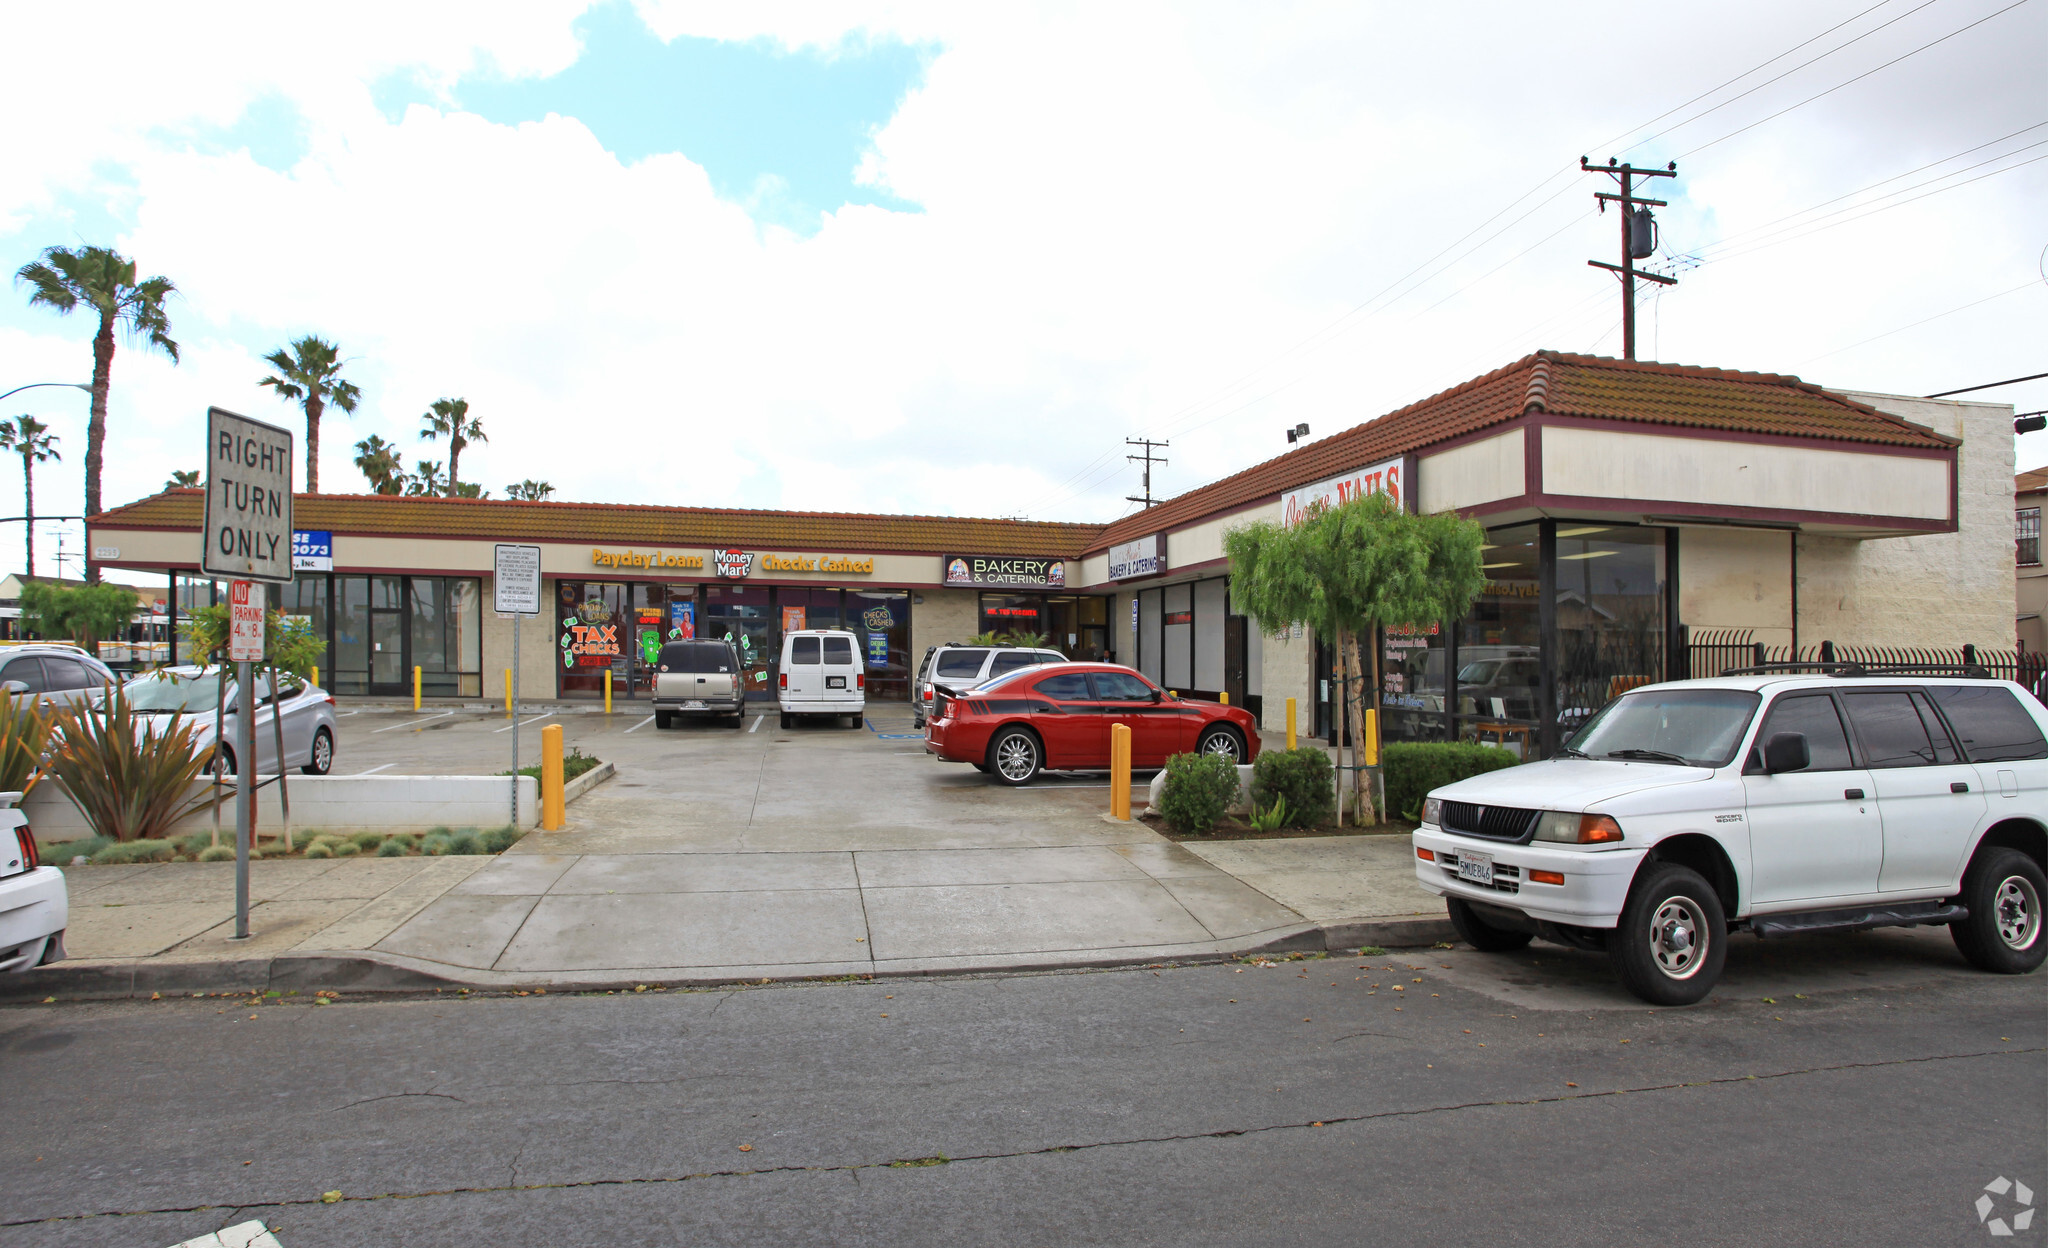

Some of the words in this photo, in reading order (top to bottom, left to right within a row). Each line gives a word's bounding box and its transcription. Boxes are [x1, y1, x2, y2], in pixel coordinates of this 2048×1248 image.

[219, 430, 287, 475] RIGHT
[220, 478, 281, 519] TURN
[219, 526, 281, 561] ONLY
[592, 548, 652, 569] Payday
[656, 551, 704, 568] Loans
[713, 549, 754, 569] Money
[761, 554, 814, 572] Checks
[819, 556, 874, 573] Cashed
[973, 559, 1048, 574] BAKERY
[1110, 562, 1127, 579] BAKERY
[1128, 562, 1132, 576] &
[1133, 556, 1157, 574] CATERING
[716, 562, 747, 577] Mart
[973, 573, 983, 582] &
[987, 573, 1046, 584] CATERING
[234, 583, 247, 602] NO
[234, 606, 263, 622] PARKING
[864, 610, 888, 619] CHECKS
[869, 618, 894, 627] CASHED
[234, 622, 240, 637] 4
[252, 623, 258, 638] 8
[572, 624, 618, 643] TAX
[571, 643, 620, 655] CHECKS
[1460, 860, 1490, 880] 5MUE846
